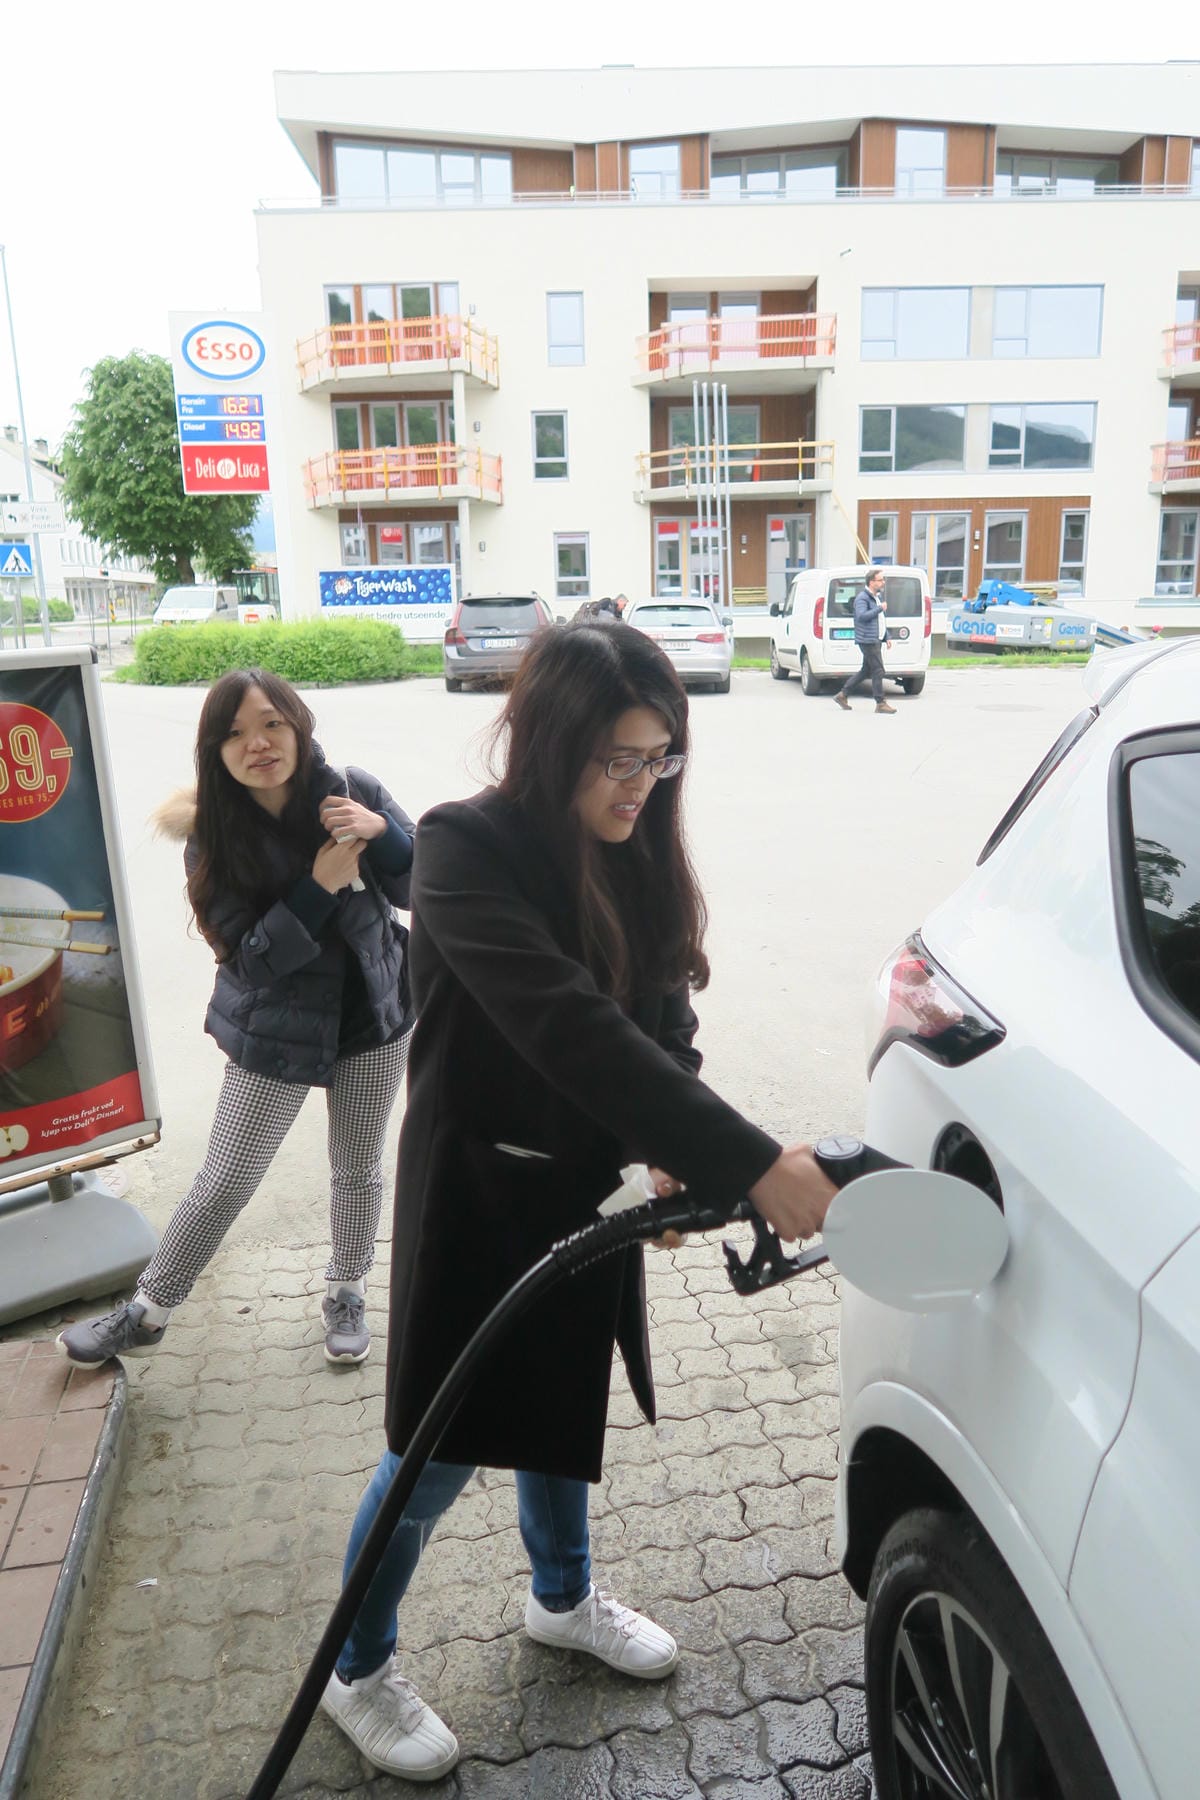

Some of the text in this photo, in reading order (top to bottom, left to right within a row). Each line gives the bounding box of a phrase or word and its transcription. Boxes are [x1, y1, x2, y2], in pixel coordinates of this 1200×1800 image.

[222, 396, 260, 414] 16.21
[183, 421, 261, 439] Diesel 14.92
[195, 457, 216, 479] Deli
[236, 457, 260, 479] Luca
[952, 615, 997, 636] Genie
[1058, 622, 1085, 635] Genie
[0, 724, 73, 795] 9,-
[17, 794, 34, 806] HER
[52, 1098, 114, 1125] Gratis frukt ved
[96, 1105, 125, 1121] Dinner!
